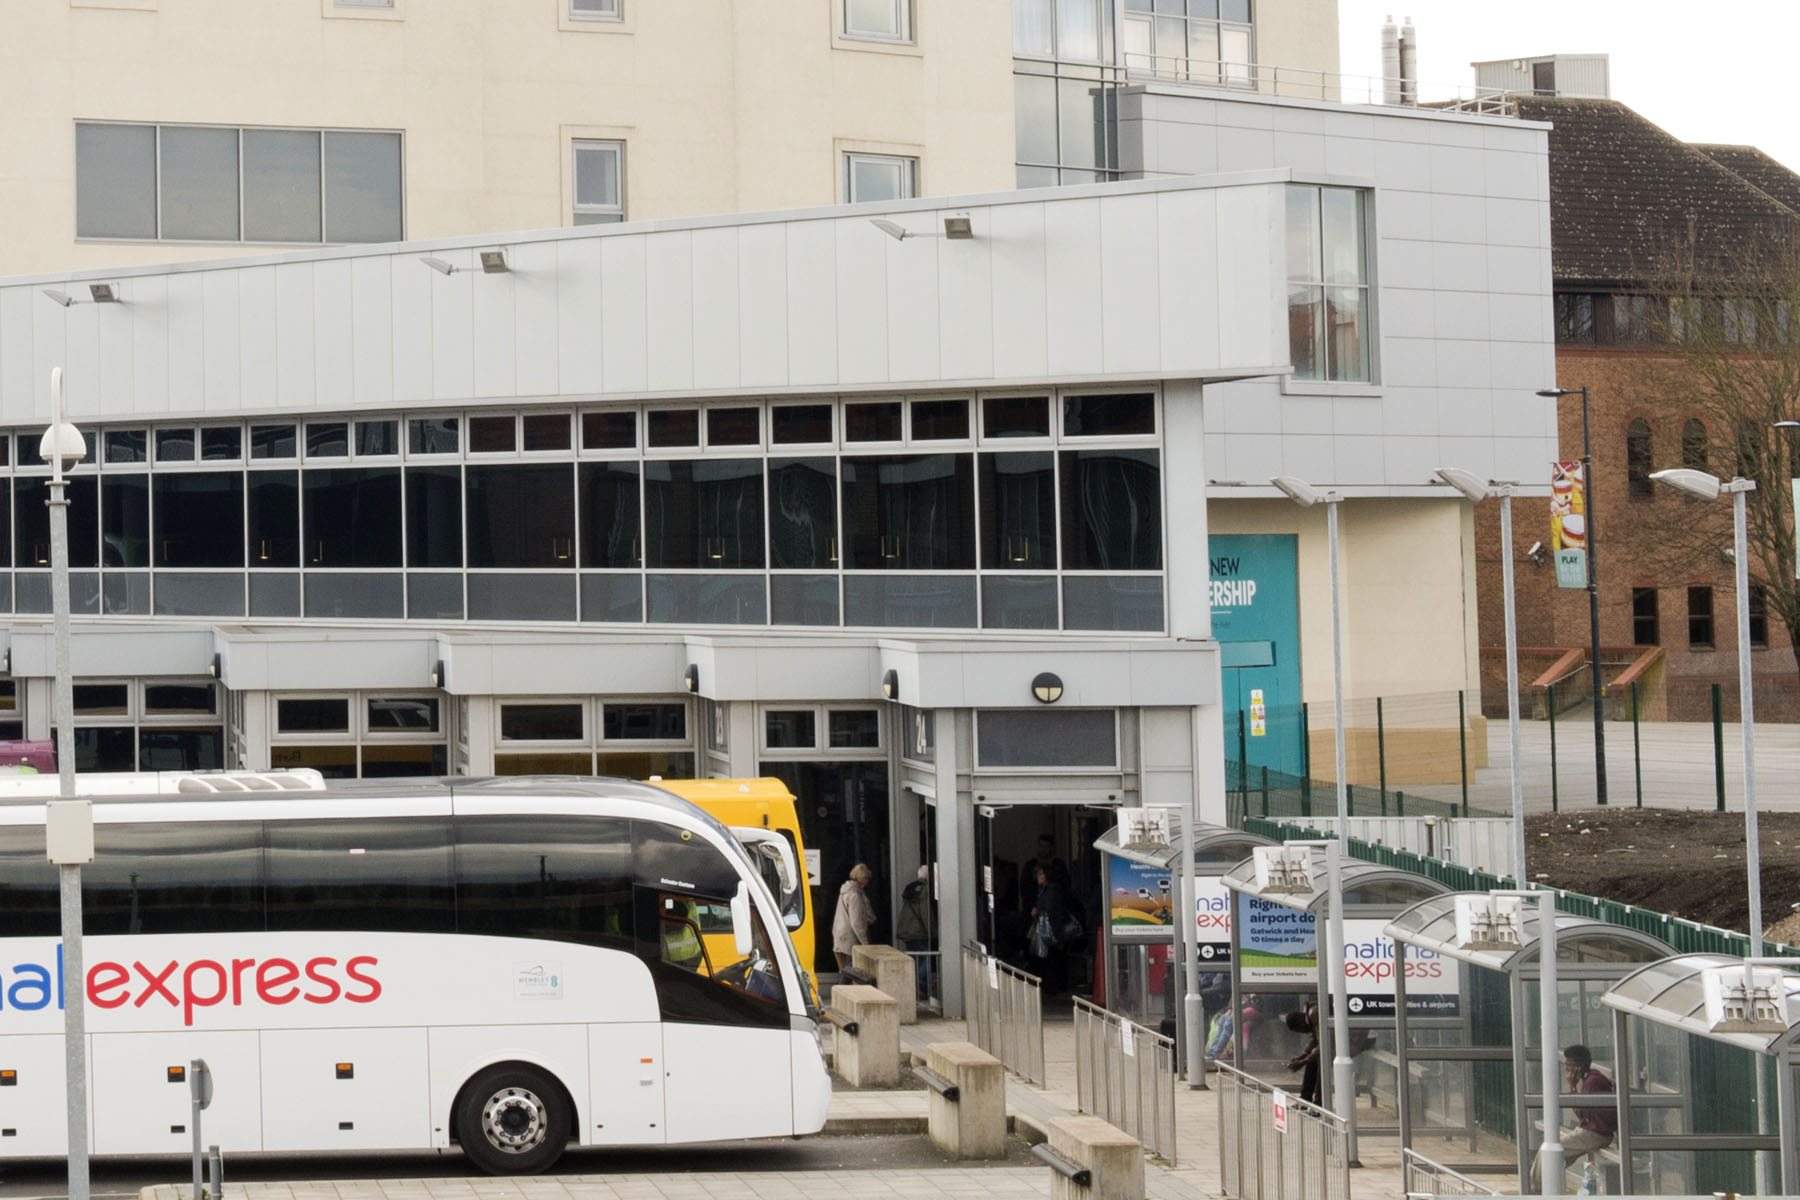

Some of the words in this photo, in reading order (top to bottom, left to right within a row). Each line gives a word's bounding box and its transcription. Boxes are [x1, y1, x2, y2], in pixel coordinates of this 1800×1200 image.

[1561, 555, 1578, 564] PLAY
[1210, 557, 1240, 577] NEW
[916, 714, 927, 755] 24
[1249, 912, 1297, 925] airport
[1250, 927, 1282, 935] Gatwick
[1283, 927, 1298, 935] and
[1290, 936, 1305, 944] day
[86, 955, 383, 1027] express
[1366, 1000, 1378, 1008] UK
[1429, 1001, 1456, 1010] airports
